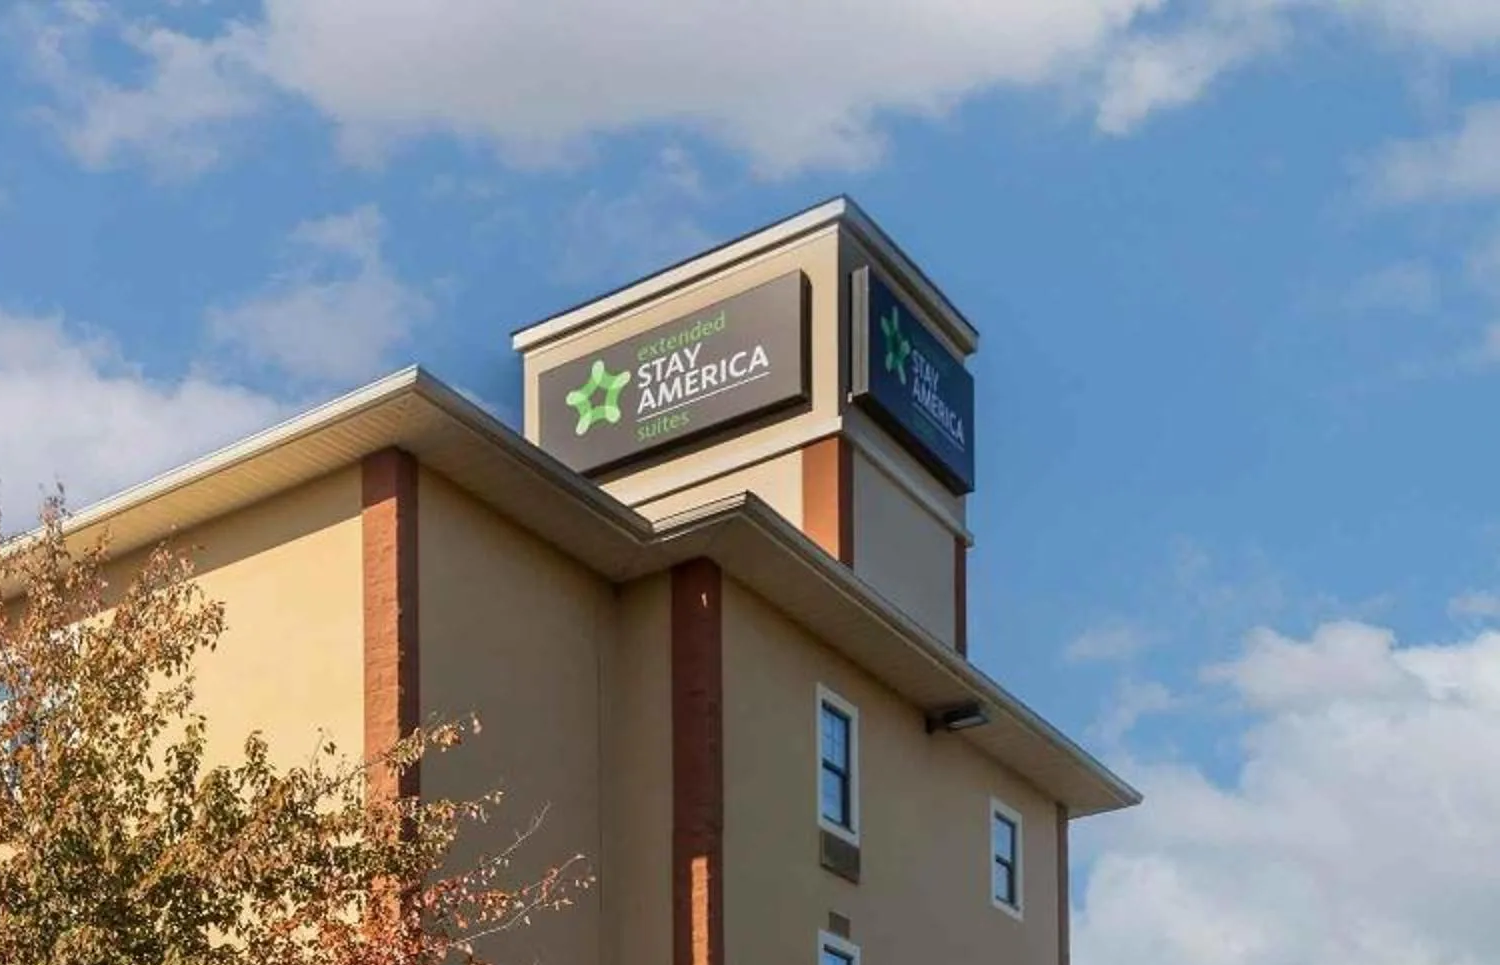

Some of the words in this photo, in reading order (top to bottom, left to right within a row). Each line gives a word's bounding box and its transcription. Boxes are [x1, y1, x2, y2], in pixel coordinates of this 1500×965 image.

[637, 310, 727, 361] extended
[637, 345, 770, 414] AMERICA
[638, 343, 702, 388] STAY
[911, 349, 939, 393] STAY
[636, 411, 691, 442] suites
[912, 377, 965, 445] AMERICA
